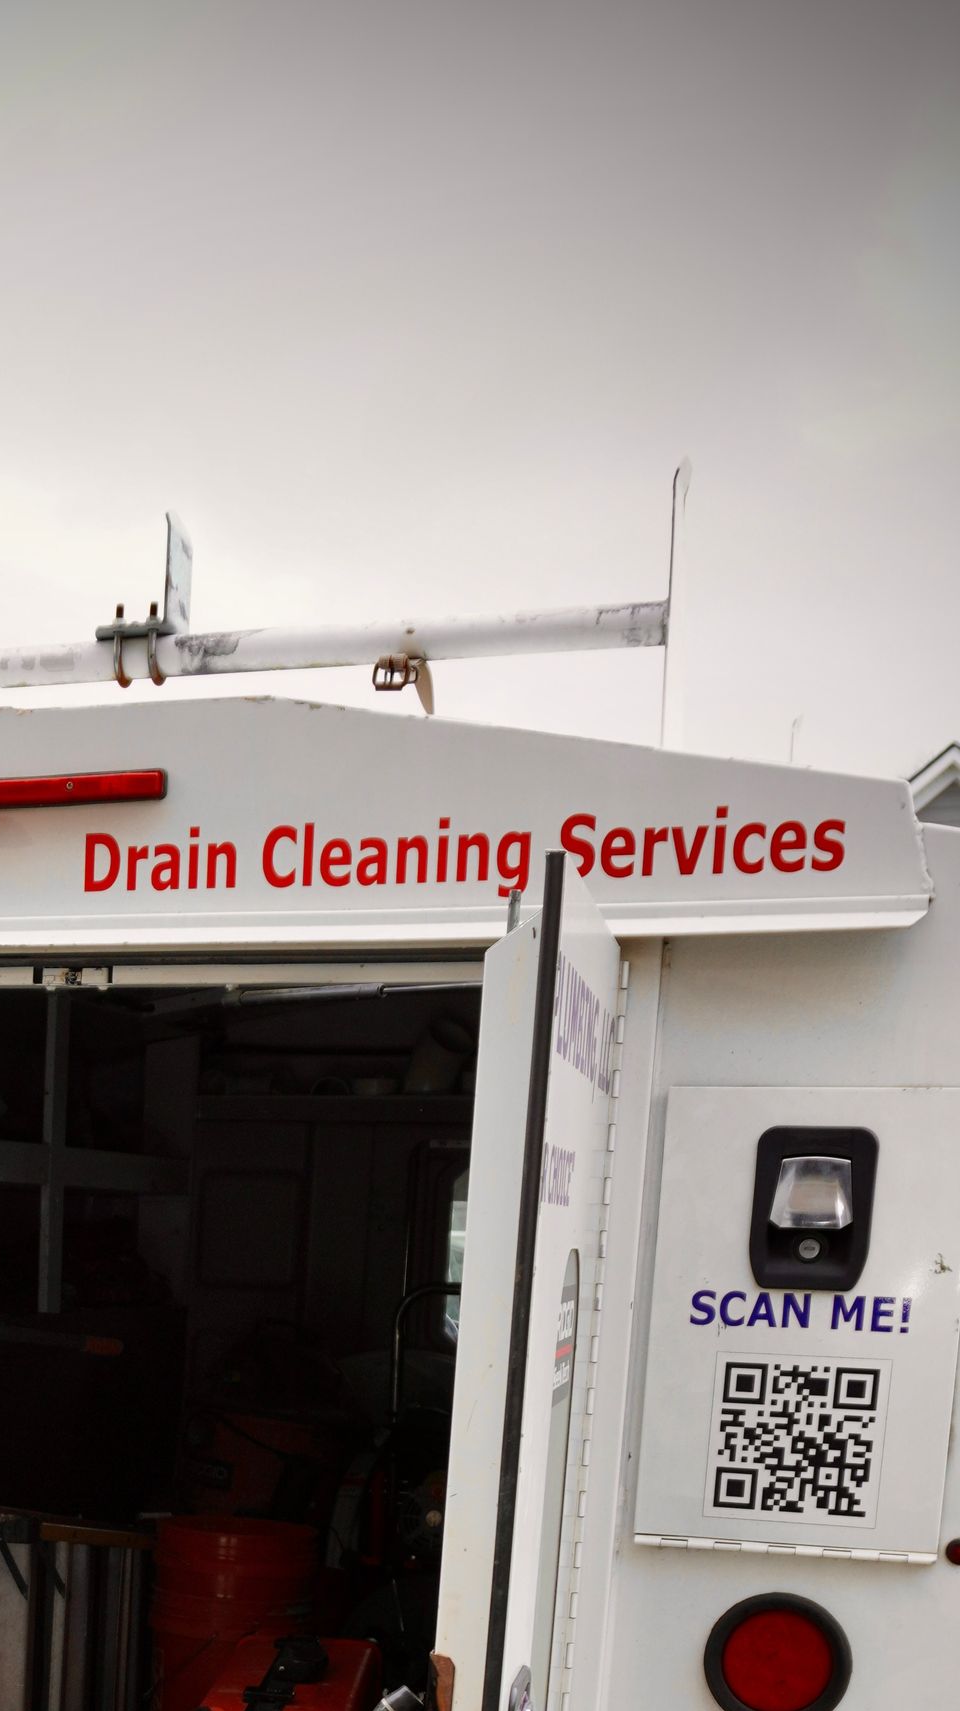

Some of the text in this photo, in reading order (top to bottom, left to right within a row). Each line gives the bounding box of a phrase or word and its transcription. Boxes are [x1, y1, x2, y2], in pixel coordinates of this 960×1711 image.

[82, 805, 847, 899] Drain Cleaning Services
[689, 1289, 911, 1334] SCAN ME!
